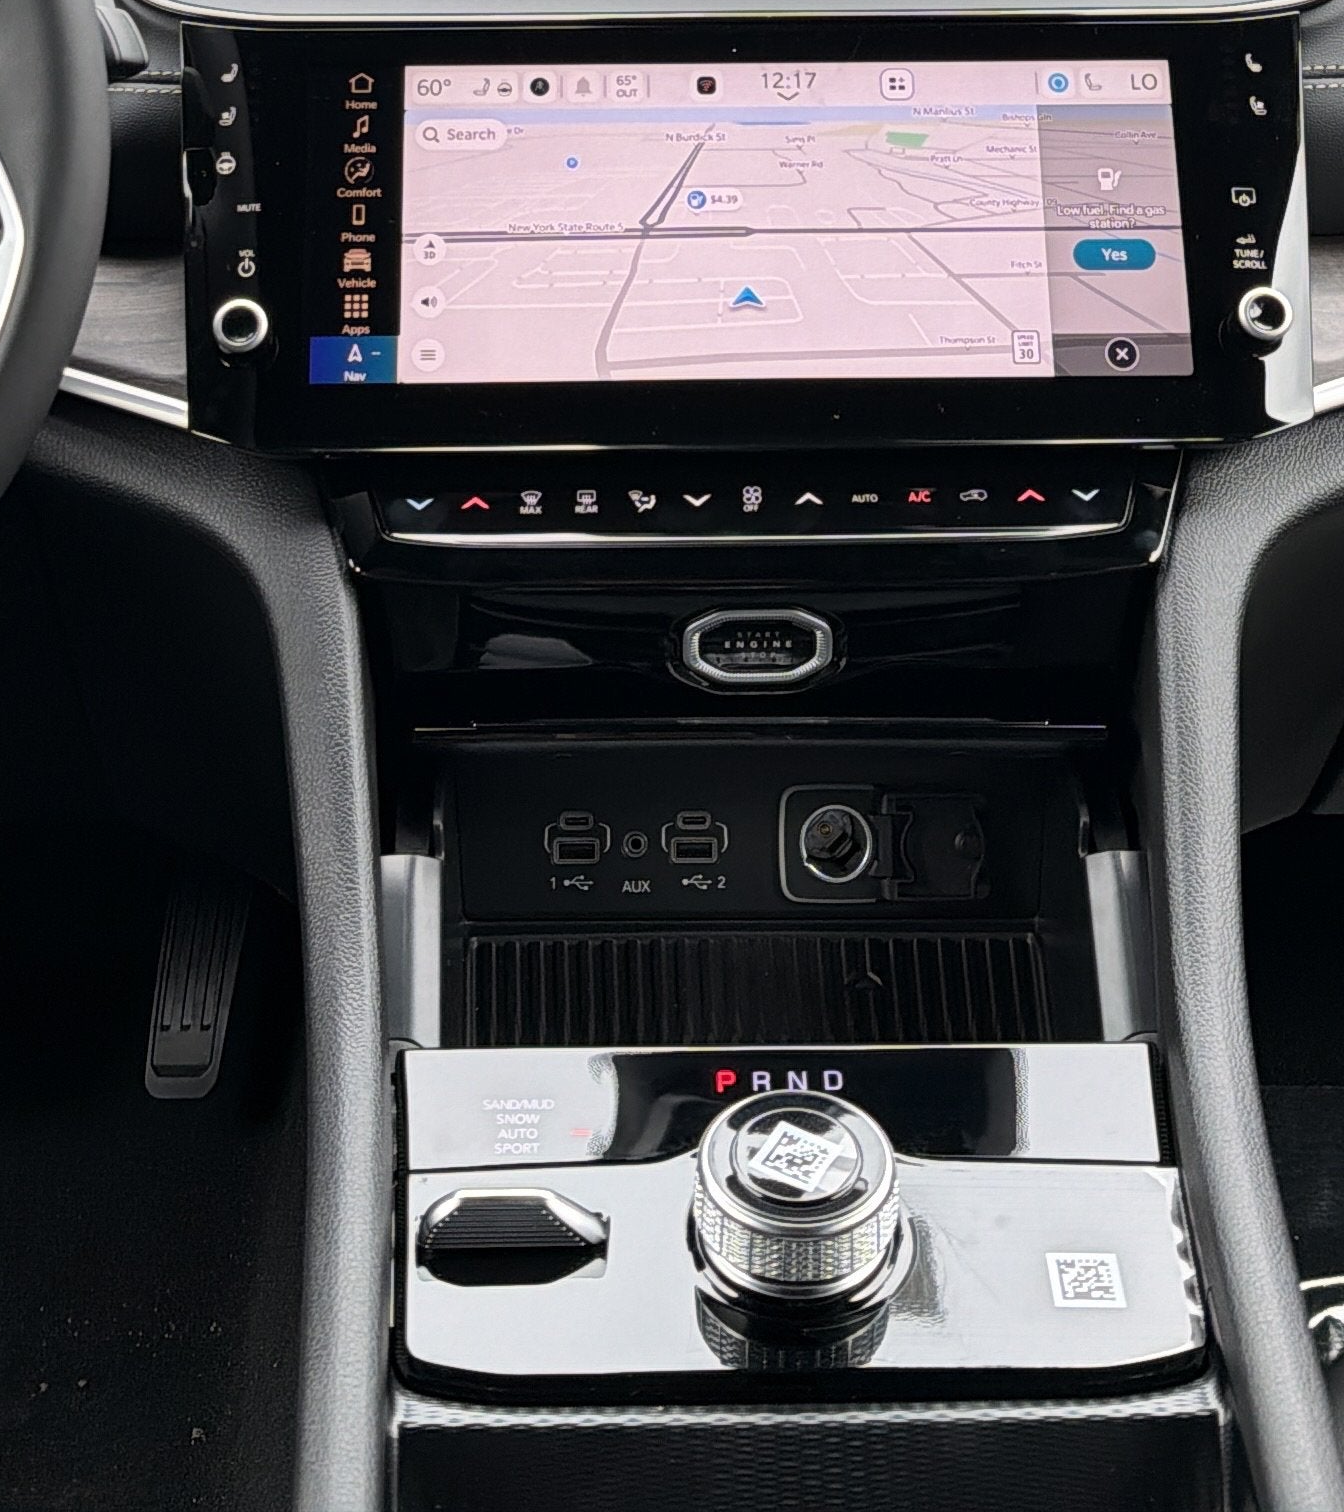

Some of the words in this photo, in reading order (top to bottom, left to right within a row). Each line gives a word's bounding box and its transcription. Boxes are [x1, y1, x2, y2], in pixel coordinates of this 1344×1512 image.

[616, 74, 638, 86] 65°
[761, 72, 817, 89] 12:17
[1131, 74, 1158, 90] LO
[417, 79, 452, 96] 60°
[616, 89, 638, 98] OUT
[345, 99, 378, 110] Home
[965, 107, 975, 116] St
[446, 128, 496, 140] Search
[715, 132, 725, 141] St
[1141, 131, 1157, 139] Ave
[343, 142, 376, 153] Media
[1027, 145, 1037, 153] St
[812, 160, 823, 168] Rd
[336, 187, 382, 198] Comfort
[237, 203, 262, 212] MUTE
[1057, 206, 1081, 215] Low
[1109, 204, 1134, 215] Find
[1145, 207, 1165, 216] gas
[508, 224, 530, 232] New
[532, 223, 555, 232] York
[558, 223, 583, 231] State
[585, 223, 614, 231] Route
[1089, 218, 1135, 228] station?
[340, 232, 376, 243] Phone
[239, 249, 255, 257] VOL
[423, 251, 436, 259] 3D
[1101, 248, 1128, 261] Yes
[1234, 249, 1264, 258] TUNE/
[1033, 260, 1043, 268] St
[1232, 260, 1268, 269] SCROLL
[337, 278, 376, 288] Vehicle
[341, 324, 370, 336] Apps
[940, 336, 983, 345] Thompson
[985, 336, 996, 344] St
[1019, 349, 1034, 360] 30
[343, 370, 366, 382] Nav
[851, 493, 878, 503] AUTO
[908, 491, 931, 502] A/C
[520, 506, 543, 514] MAX
[574, 505, 598, 514] REAR
[743, 504, 759, 512] OFF
[724, 640, 792, 648] ENGINE
[549, 877, 556, 889] 1
[621, 880, 651, 893] AUX
[717, 876, 727, 889] 2
[716, 1069, 737, 1093] P
[752, 1070, 771, 1092] R
[787, 1070, 808, 1091] N
[823, 1070, 844, 1091] D
[482, 1099, 555, 1110] SAND/MUD
[496, 1114, 541, 1125] SNOW
[497, 1128, 538, 1139] AUTO
[494, 1143, 540, 1154] SPORT
